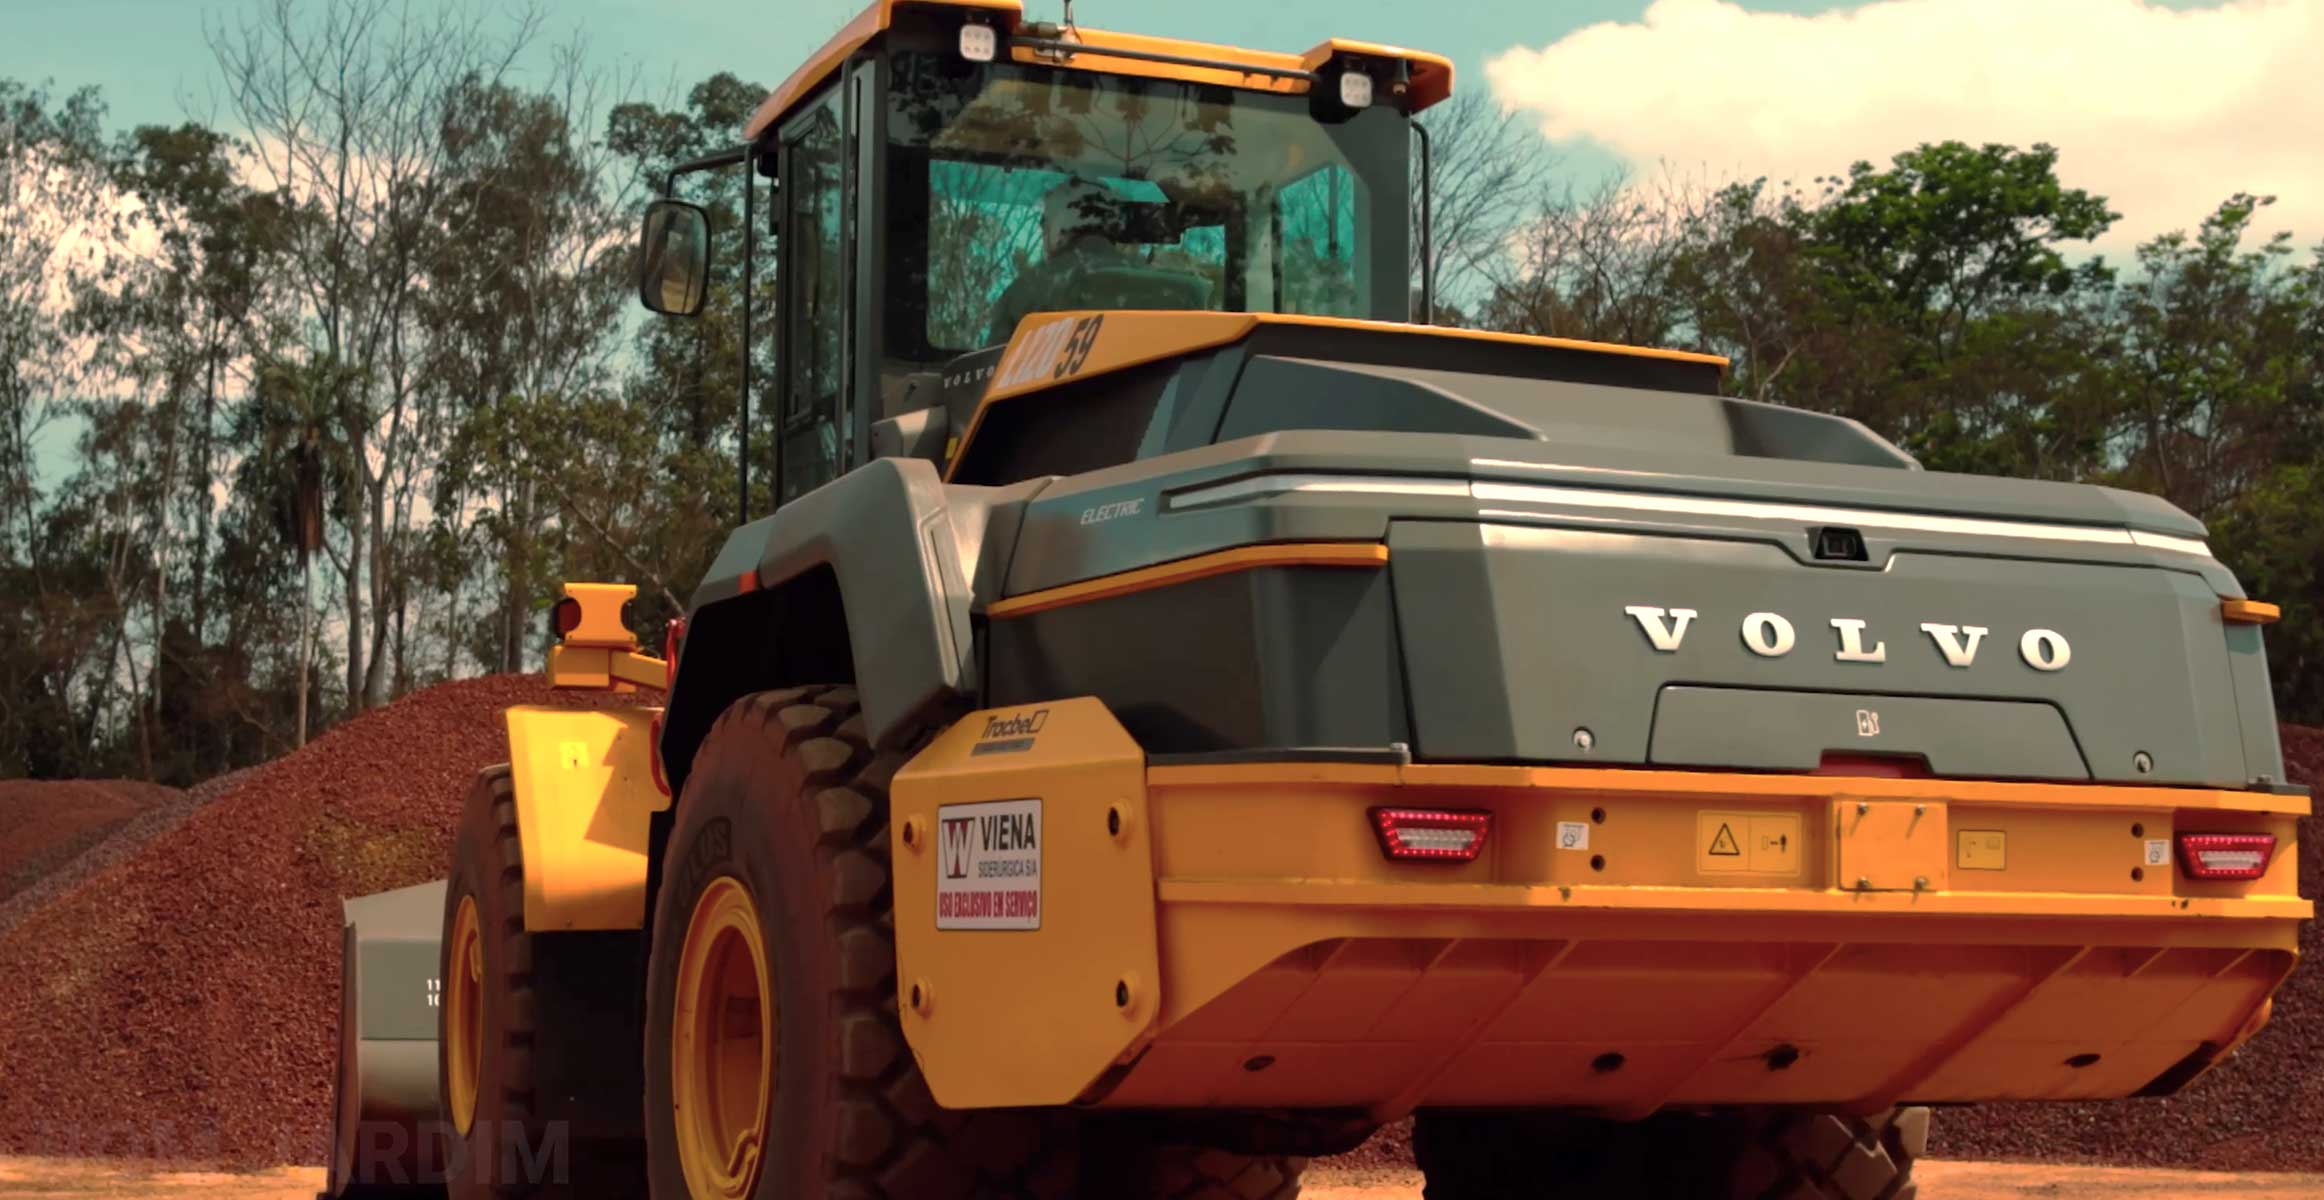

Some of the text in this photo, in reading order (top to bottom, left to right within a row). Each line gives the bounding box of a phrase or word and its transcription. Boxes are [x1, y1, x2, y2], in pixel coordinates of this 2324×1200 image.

[1054, 313, 1105, 378] 59
[944, 365, 995, 389] VOLVO
[1079, 497, 1145, 527] ELECTRIC
[1624, 605, 2072, 672] VOLVO
[981, 812, 1036, 852] VIENA
[939, 891, 953, 918] USO
[954, 890, 992, 918] EXCLUSIVO
